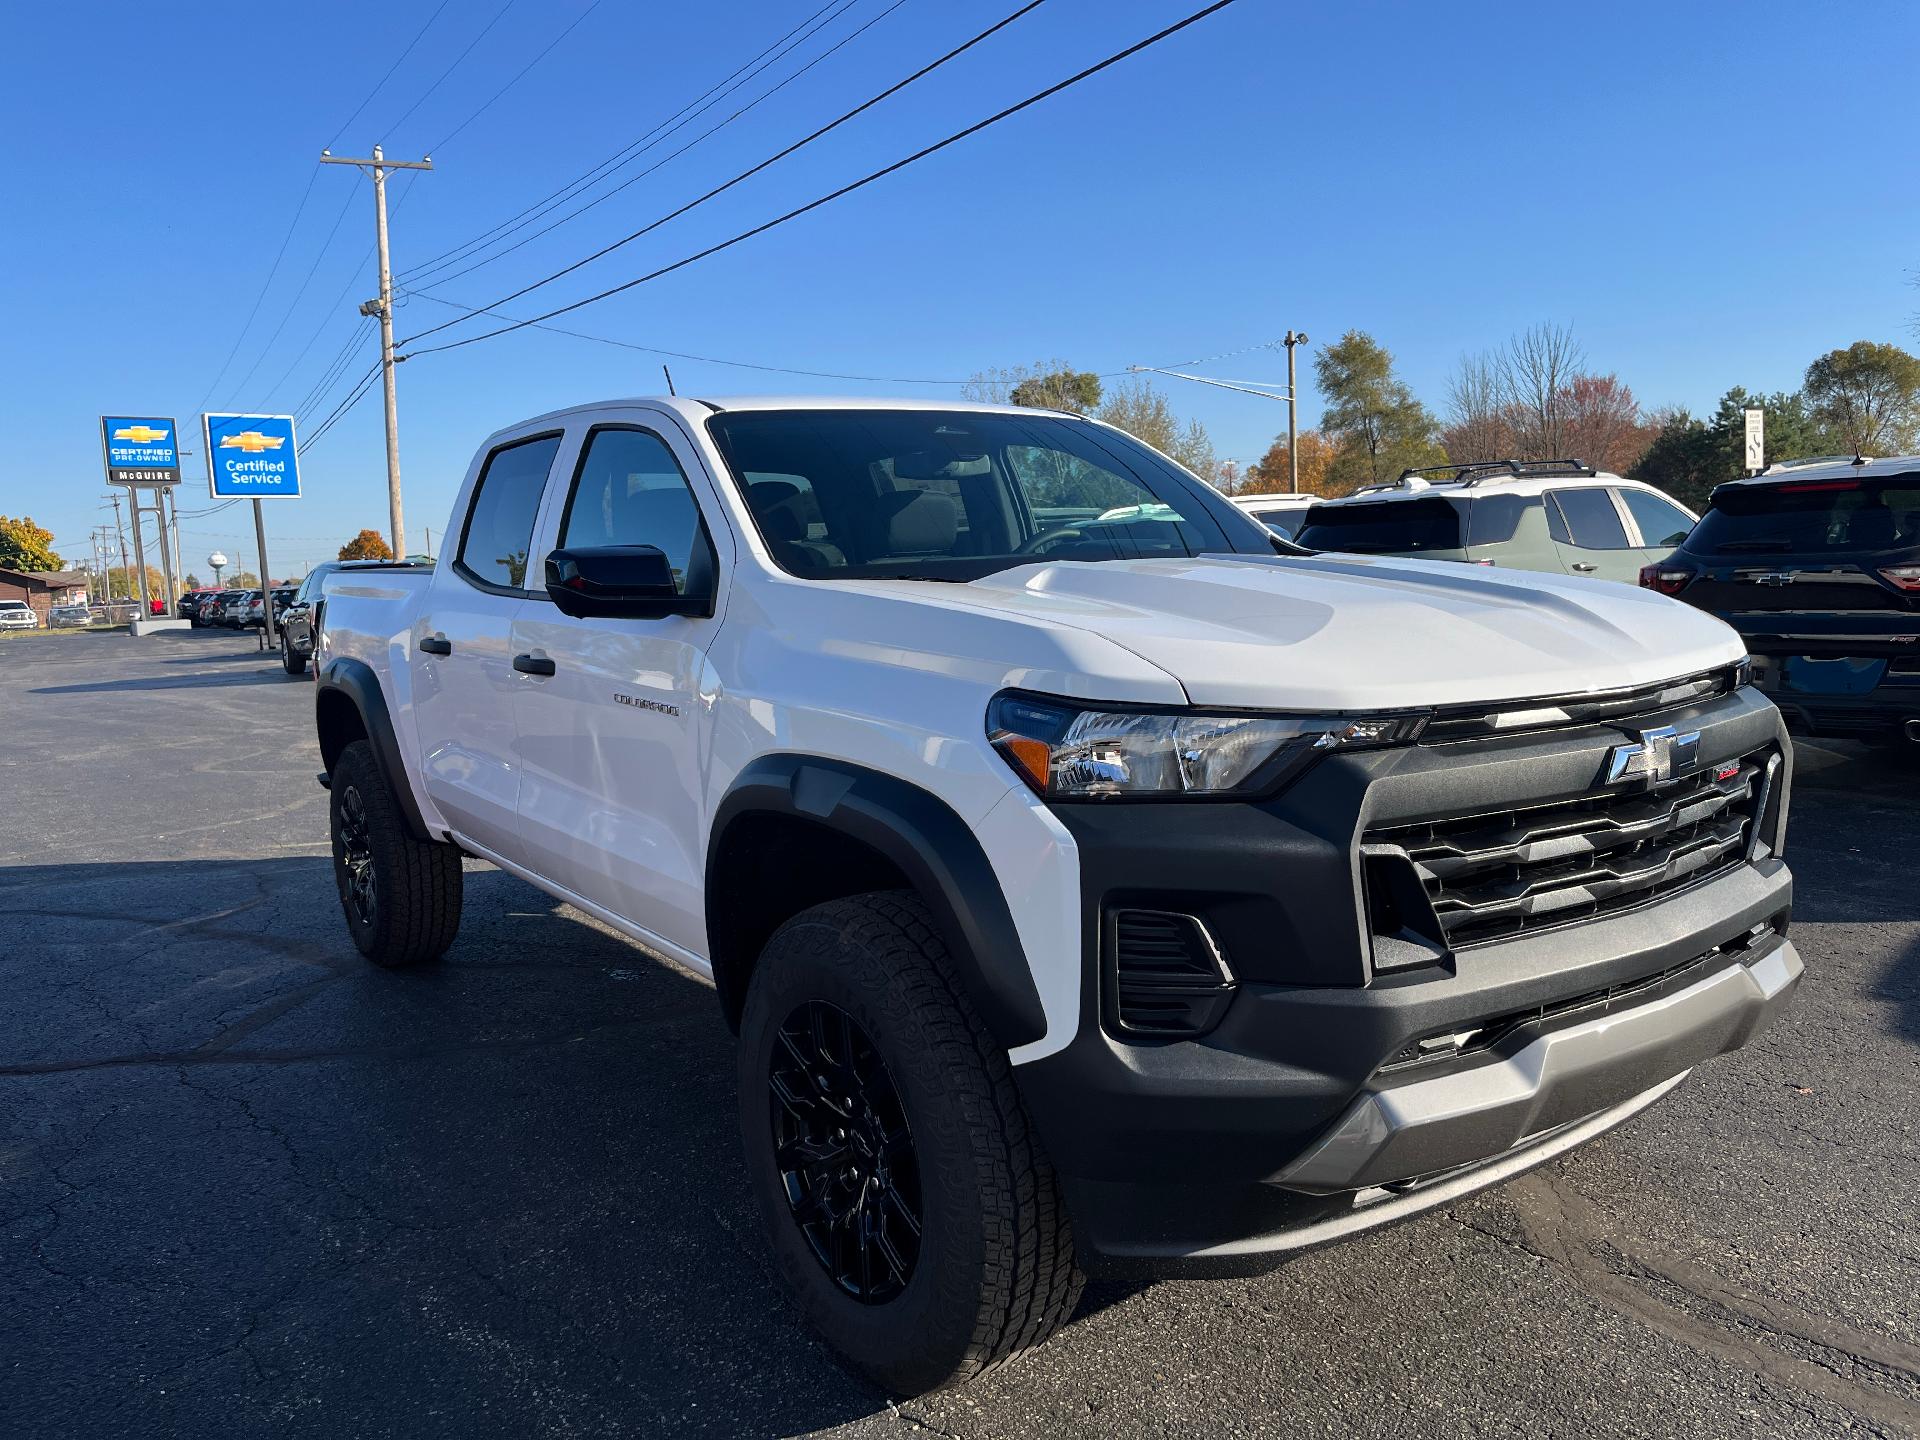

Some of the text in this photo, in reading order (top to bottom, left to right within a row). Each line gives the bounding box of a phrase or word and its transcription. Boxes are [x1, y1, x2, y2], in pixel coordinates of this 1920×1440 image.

[225, 459, 285, 472] Certified
[119, 471, 171, 480] McGUIRE
[231, 472, 282, 484] Service
